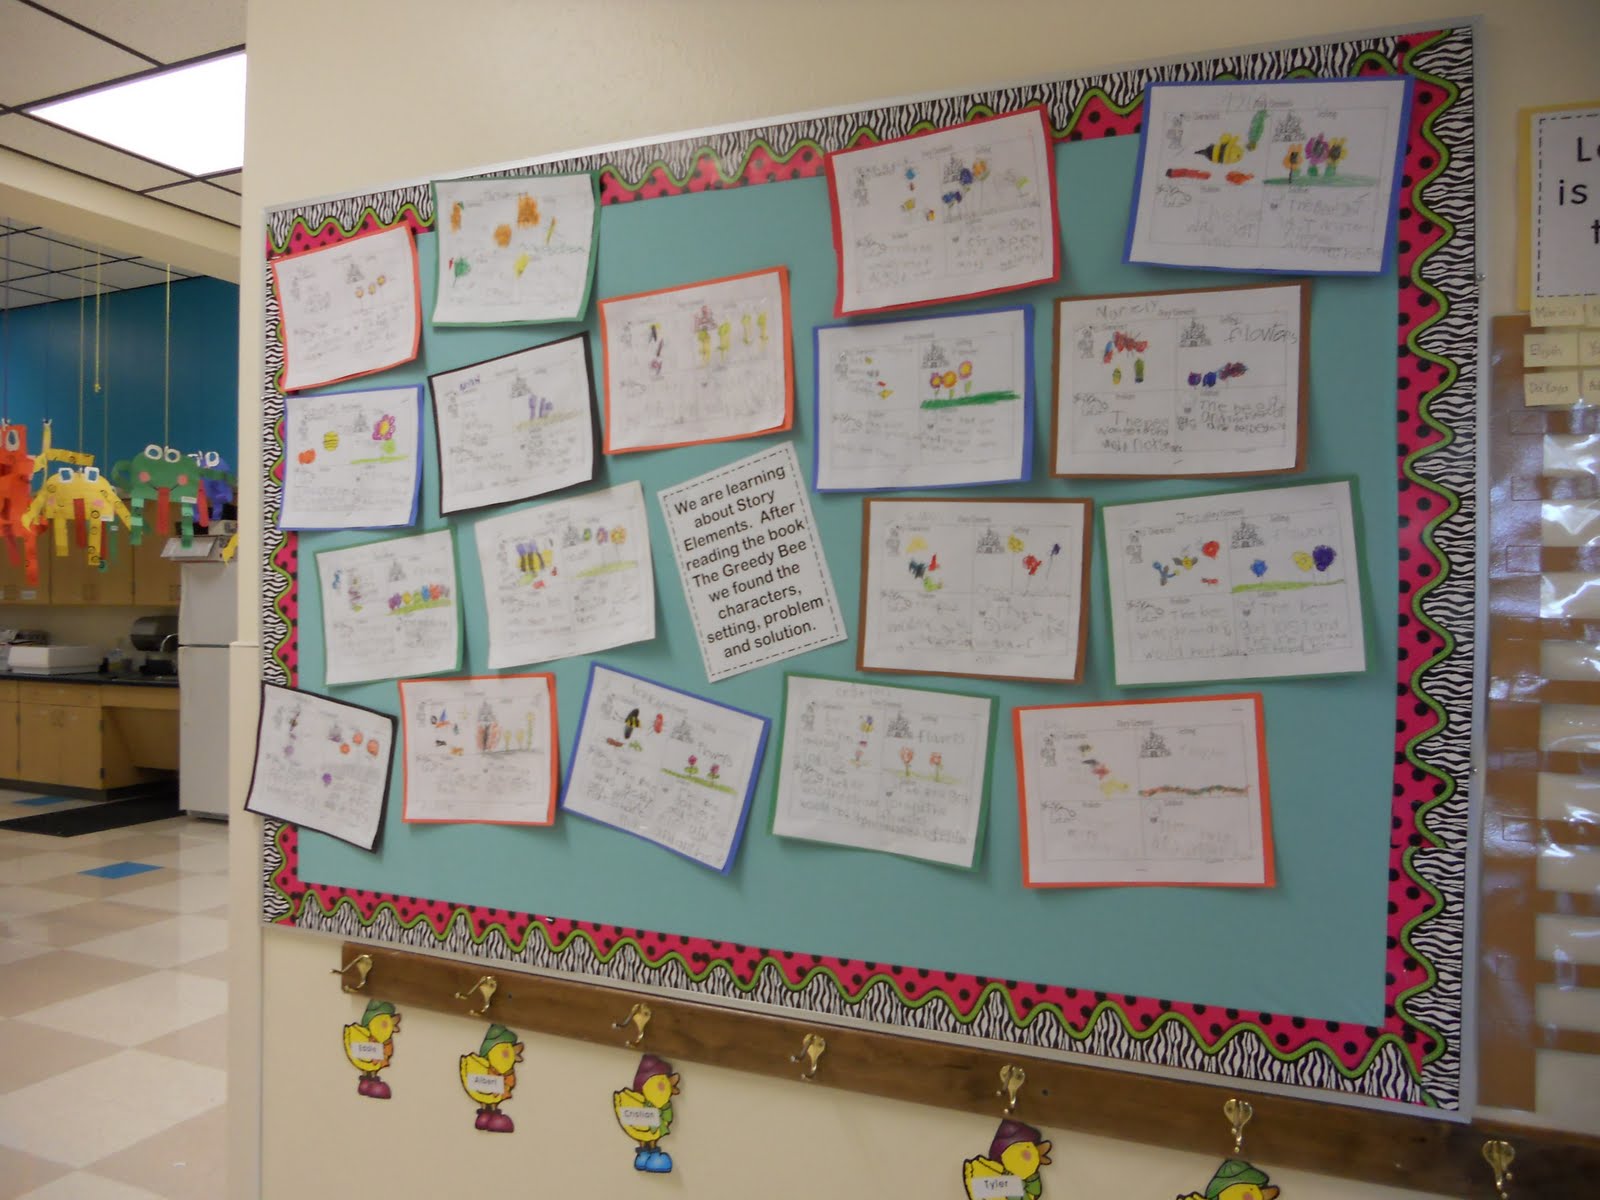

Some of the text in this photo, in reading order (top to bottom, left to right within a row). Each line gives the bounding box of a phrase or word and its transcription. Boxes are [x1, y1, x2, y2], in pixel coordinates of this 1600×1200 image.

[1577, 136, 1600, 162] L
[1559, 179, 1588, 206] is
[674, 465, 786, 515] We are learning
[695, 489, 776, 528] about Story
[684, 501, 796, 551] Elements. After
[685, 519, 806, 571] reading the book
[692, 539, 807, 588] The Greedy Bee
[709, 562, 800, 603] we found the
[707, 597, 824, 644] setting, problem
[718, 584, 802, 620] characters,
[724, 622, 816, 658] and solution.
[983, 1178, 1009, 1191] Tyler
